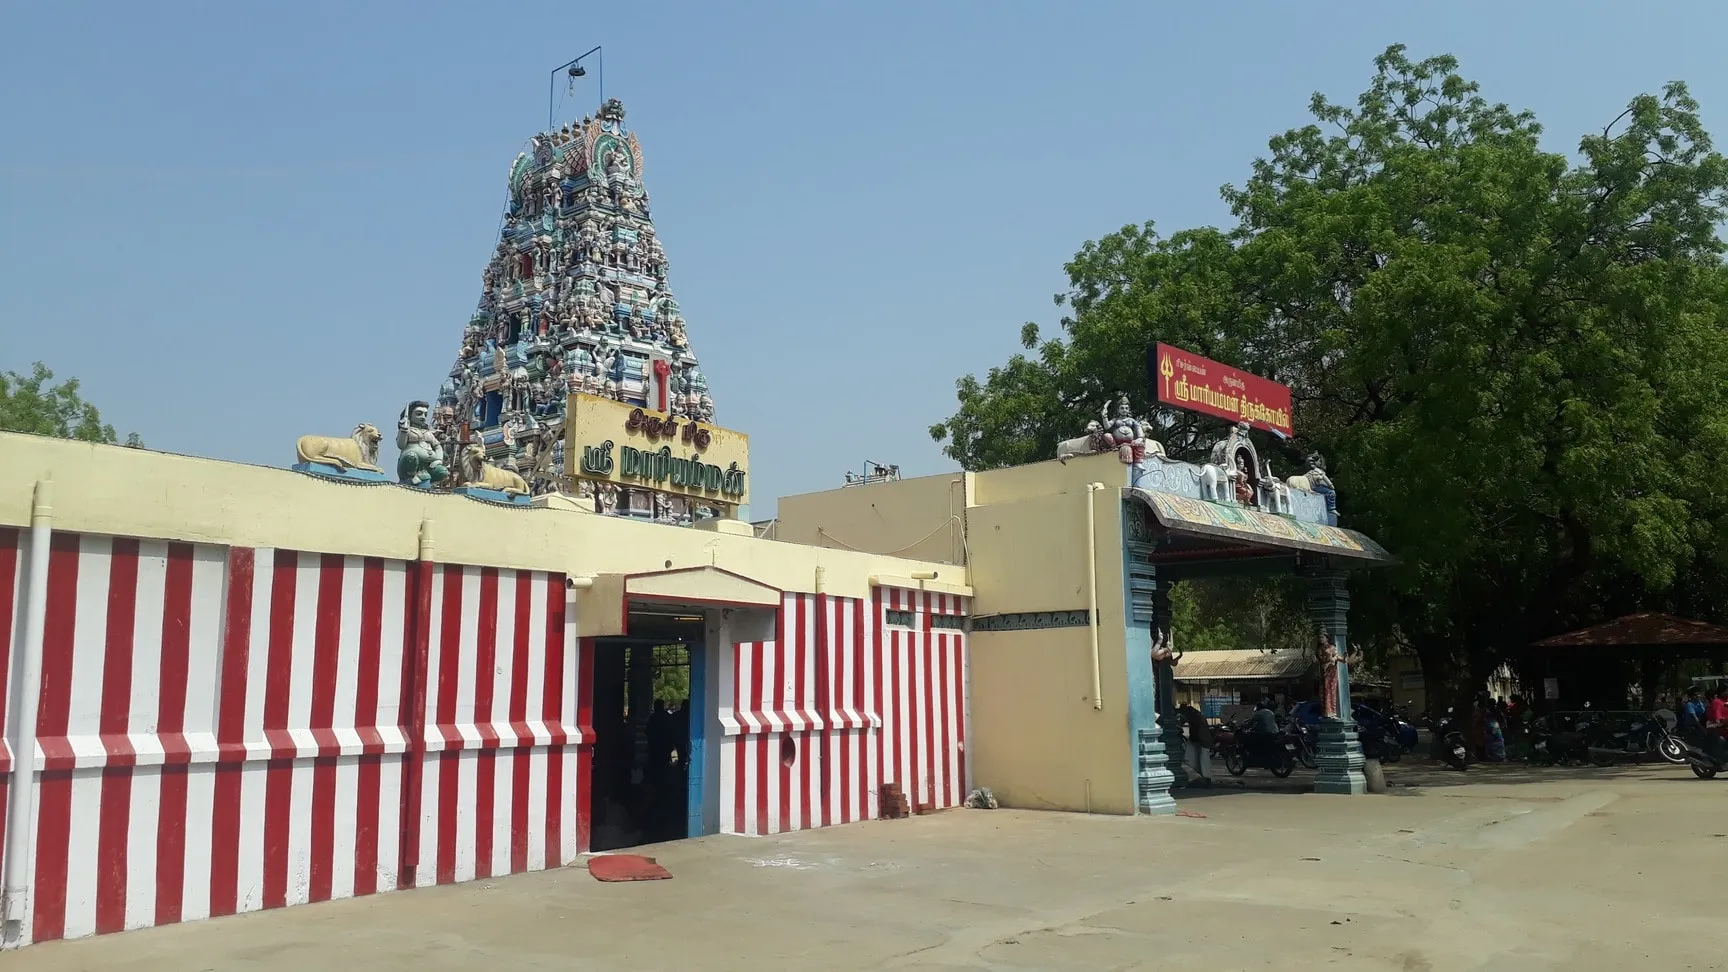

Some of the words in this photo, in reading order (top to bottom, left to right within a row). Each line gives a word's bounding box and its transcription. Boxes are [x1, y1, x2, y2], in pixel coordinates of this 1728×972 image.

[629, 408, 678, 437] அருள்
[682, 421, 711, 448] மிகு
[1190, 383, 1239, 413] மாரியம்மன்
[1240, 394, 1290, 429] திருக்கோயில்
[620, 445, 746, 497] மாரியம்மன்
